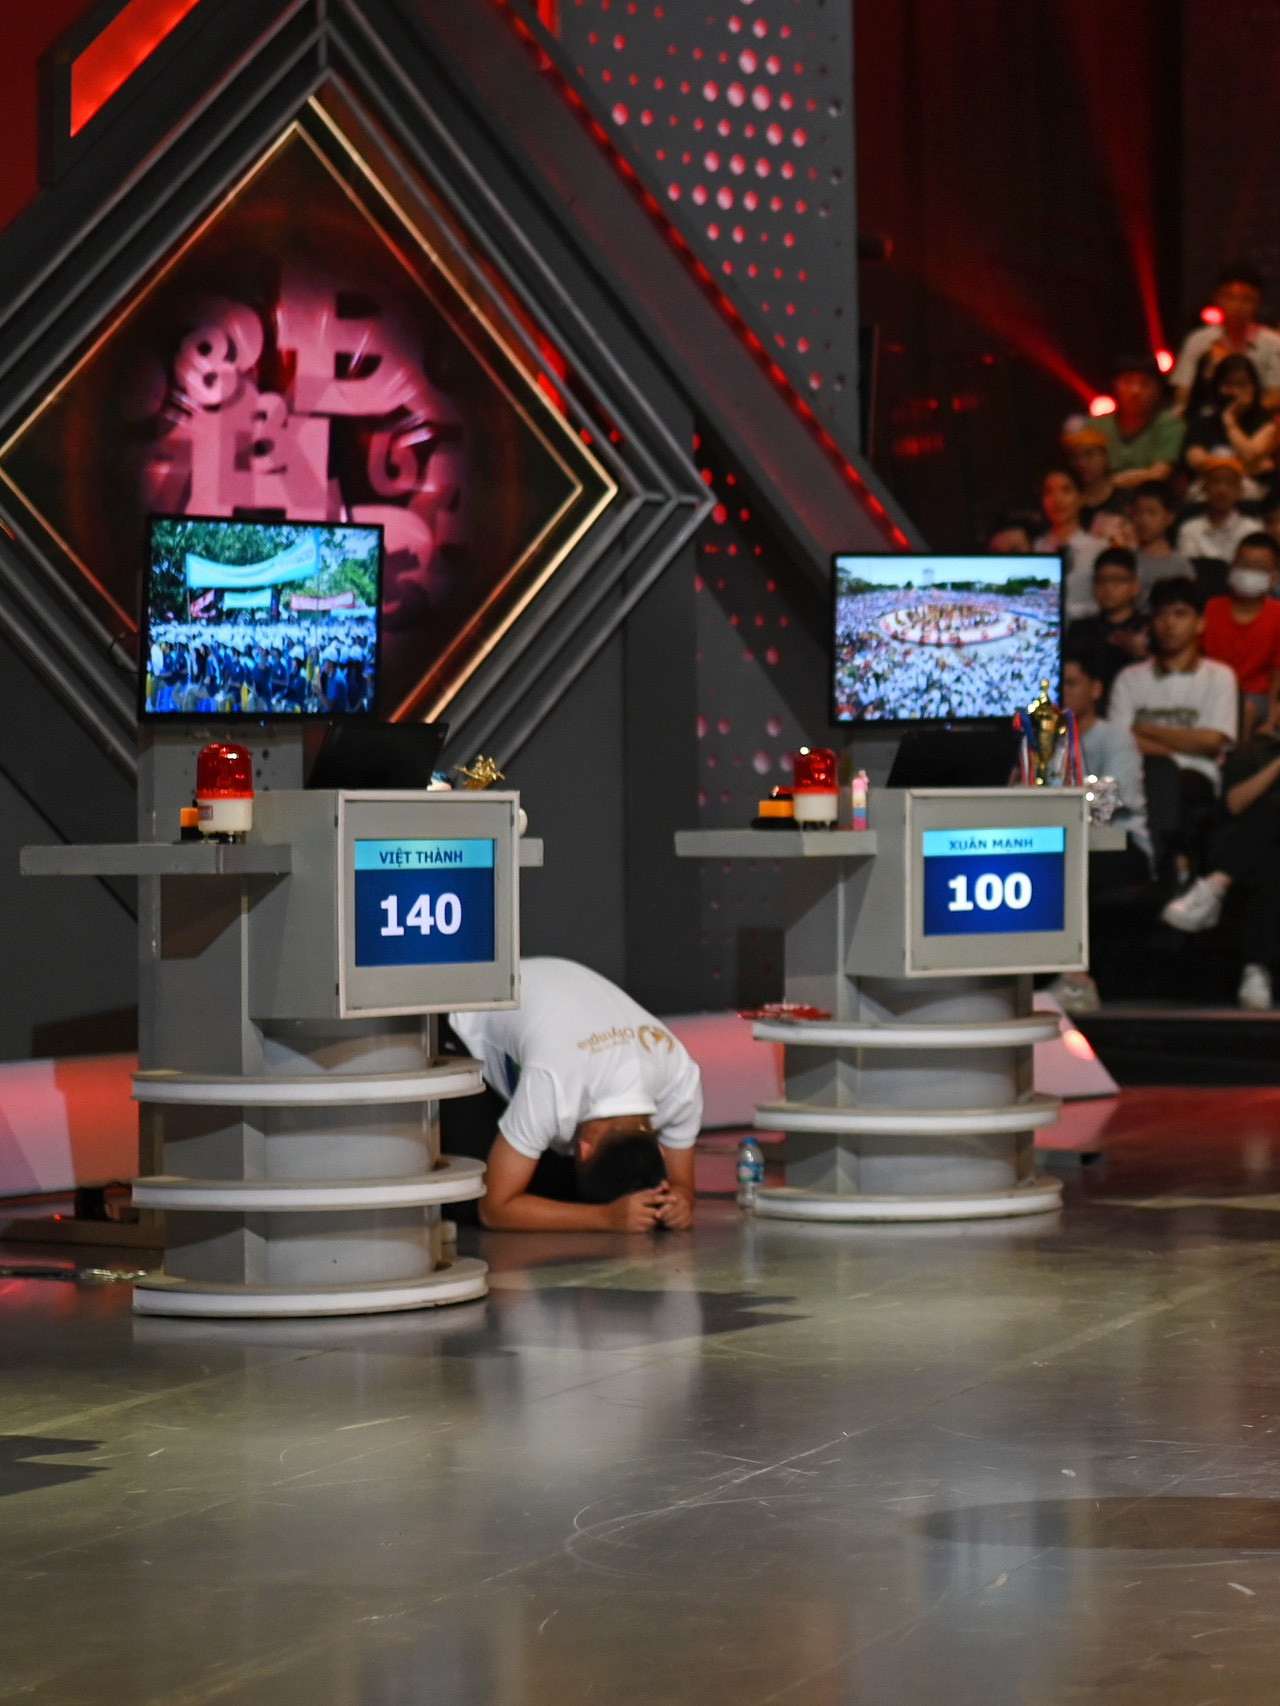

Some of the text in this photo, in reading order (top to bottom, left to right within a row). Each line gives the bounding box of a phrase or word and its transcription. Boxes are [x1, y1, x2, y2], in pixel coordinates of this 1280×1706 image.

[379, 847, 463, 868] VIỆT THÀNH
[948, 872, 1032, 912] 100
[380, 892, 462, 936] 140
